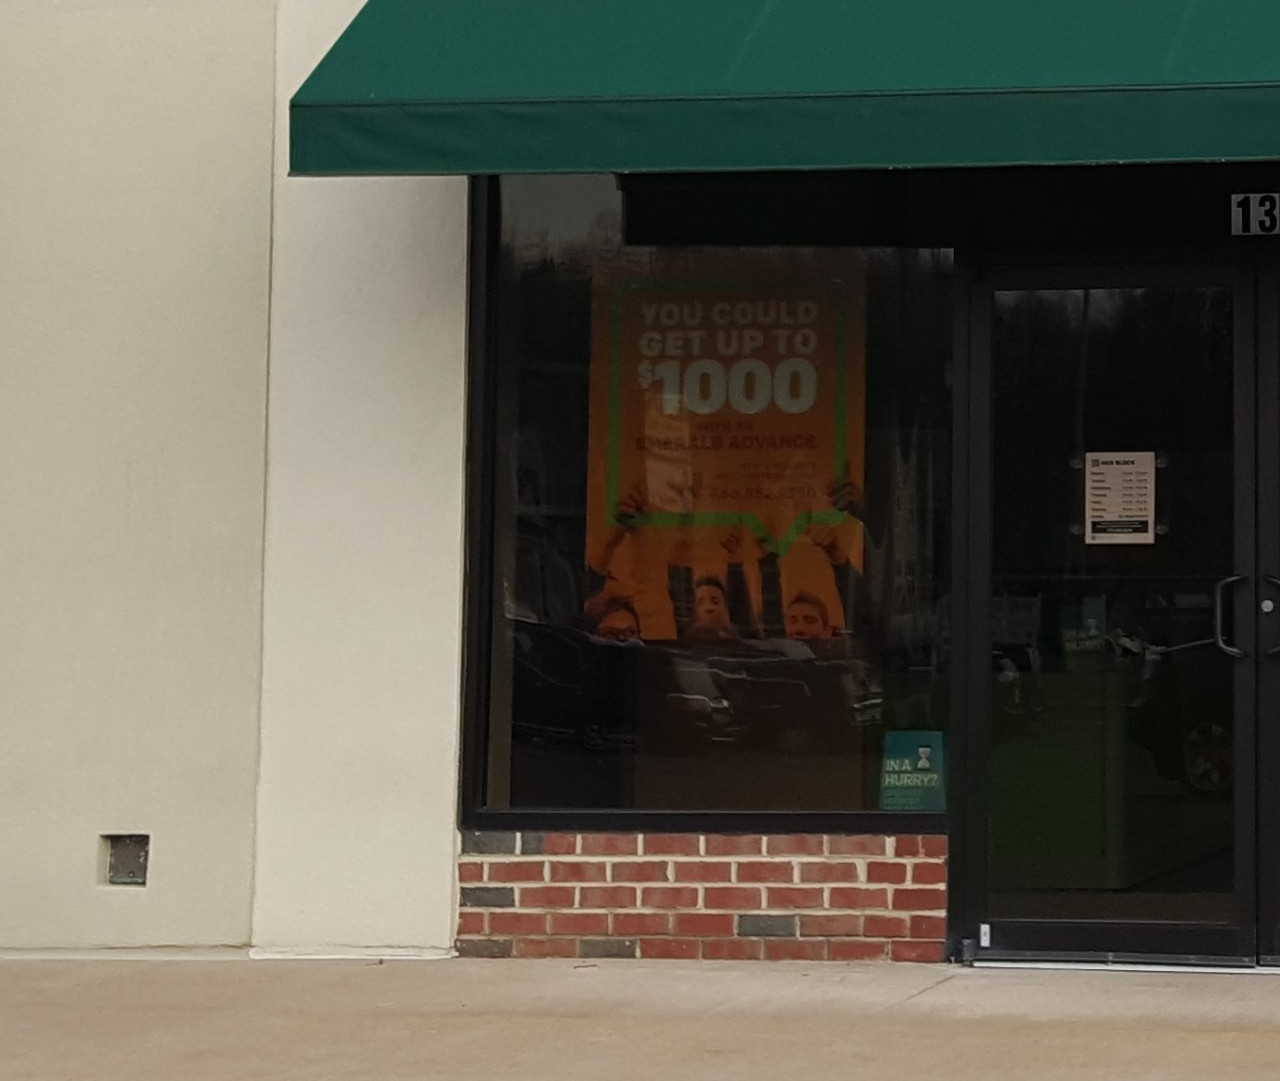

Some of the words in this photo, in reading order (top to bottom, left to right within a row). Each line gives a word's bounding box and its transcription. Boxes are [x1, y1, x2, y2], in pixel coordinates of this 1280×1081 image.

[1236, 194, 1278, 234] 13
[641, 302, 702, 327] YOU
[711, 300, 818, 325] COULD
[639, 329, 708, 357] GET
[716, 329, 764, 357] UP
[773, 327, 818, 355] TO
[885, 773, 938, 786] HURRY?
